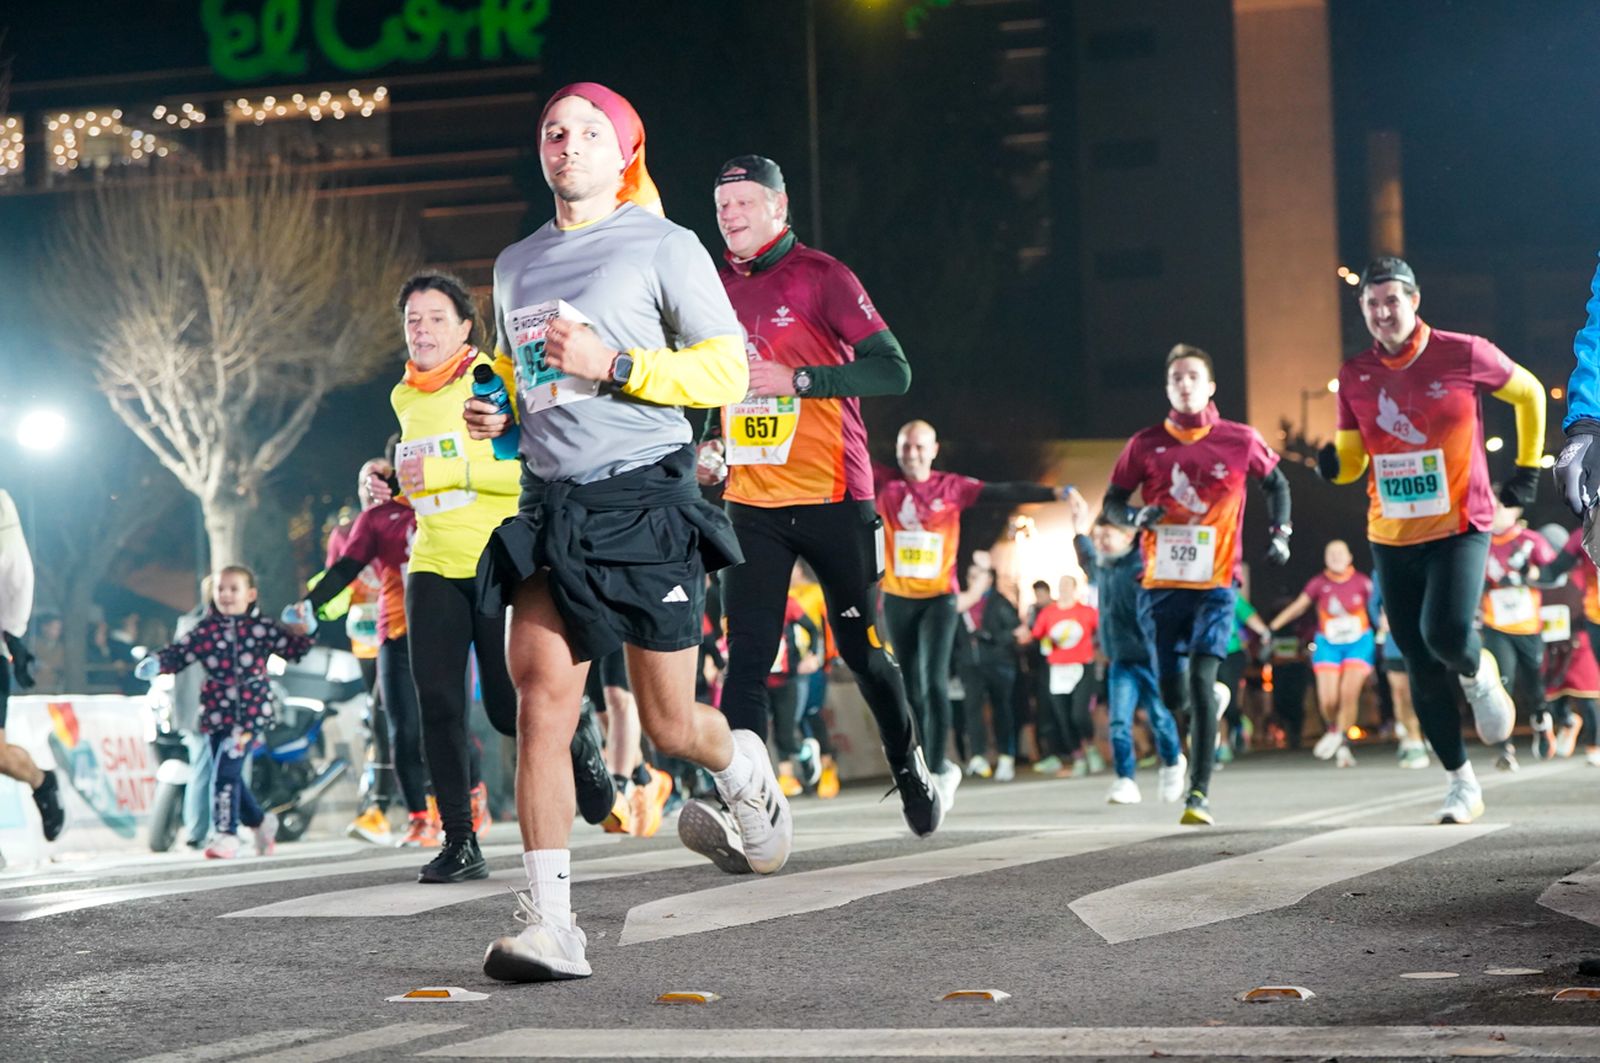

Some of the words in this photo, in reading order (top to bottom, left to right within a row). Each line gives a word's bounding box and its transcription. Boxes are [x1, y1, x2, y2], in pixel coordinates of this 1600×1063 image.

[202, 0, 308, 82] El
[311, 0, 550, 71] Corte
[745, 416, 778, 438] 657
[1383, 474, 1438, 497] 12069
[1171, 546, 1198, 562] 529
[102, 736, 147, 771] SAN
[116, 775, 157, 813] ANT
